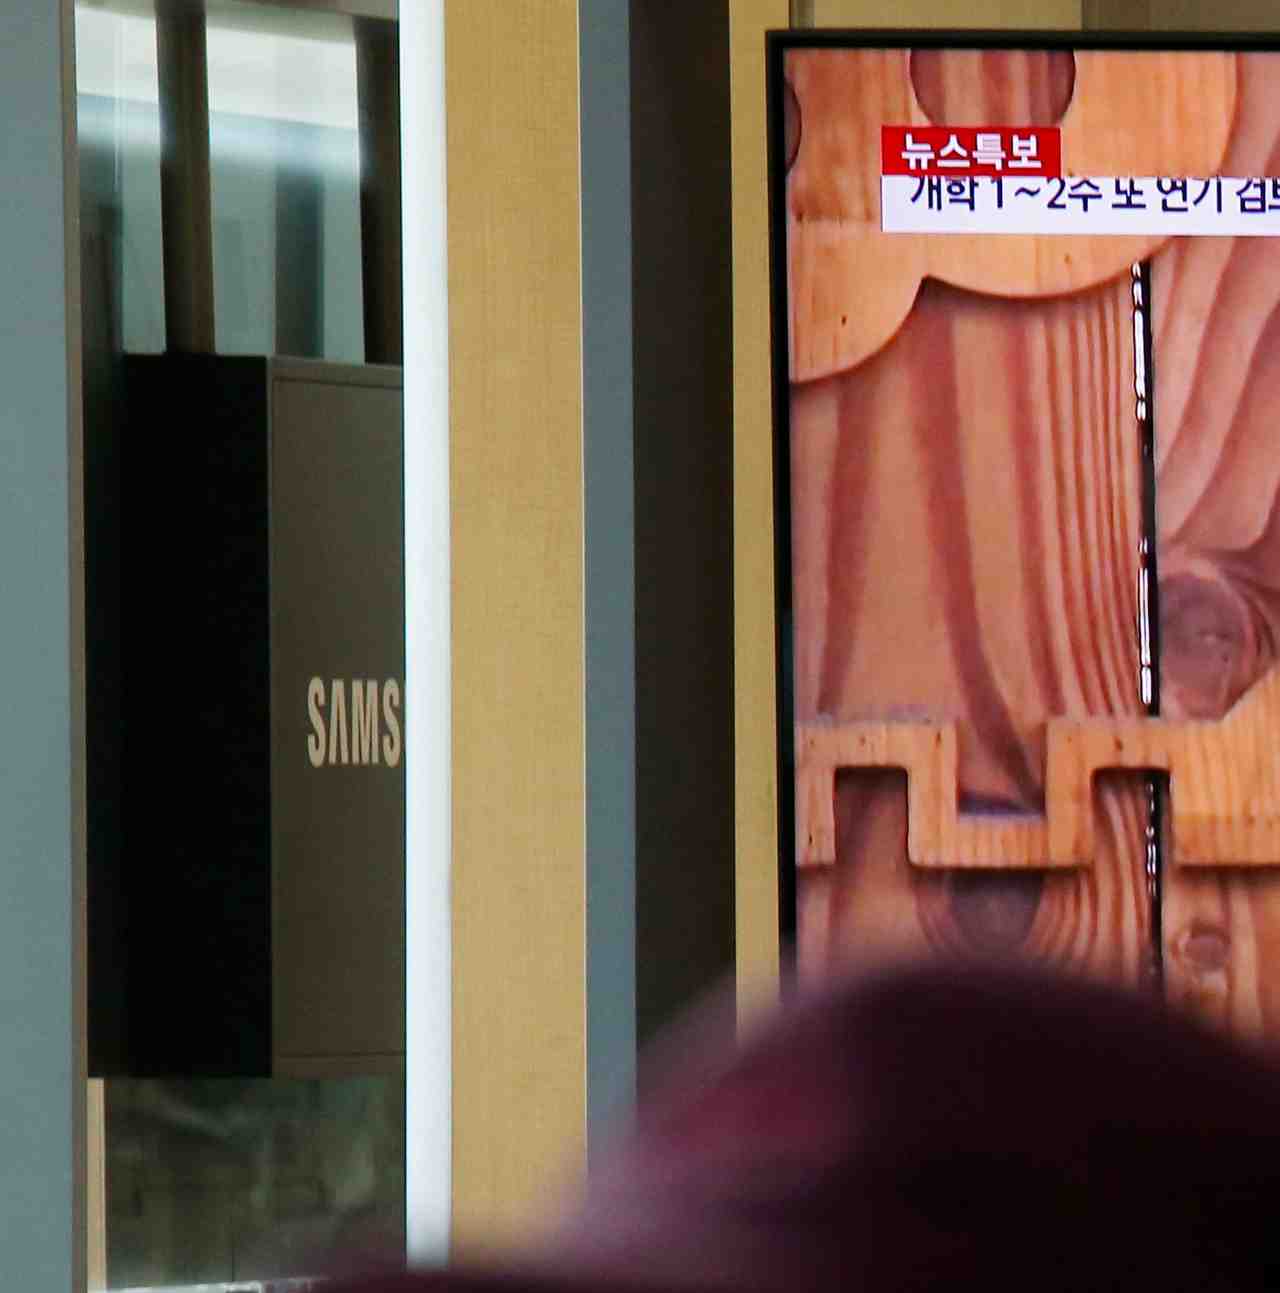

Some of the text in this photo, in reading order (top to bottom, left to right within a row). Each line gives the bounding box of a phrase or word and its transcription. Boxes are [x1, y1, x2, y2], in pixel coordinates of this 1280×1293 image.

[901, 132, 1043, 171] 뉴스특보
[910, 175, 979, 212] 개학
[1156, 176, 1223, 213] 연기
[307, 676, 401, 768] SAMS
